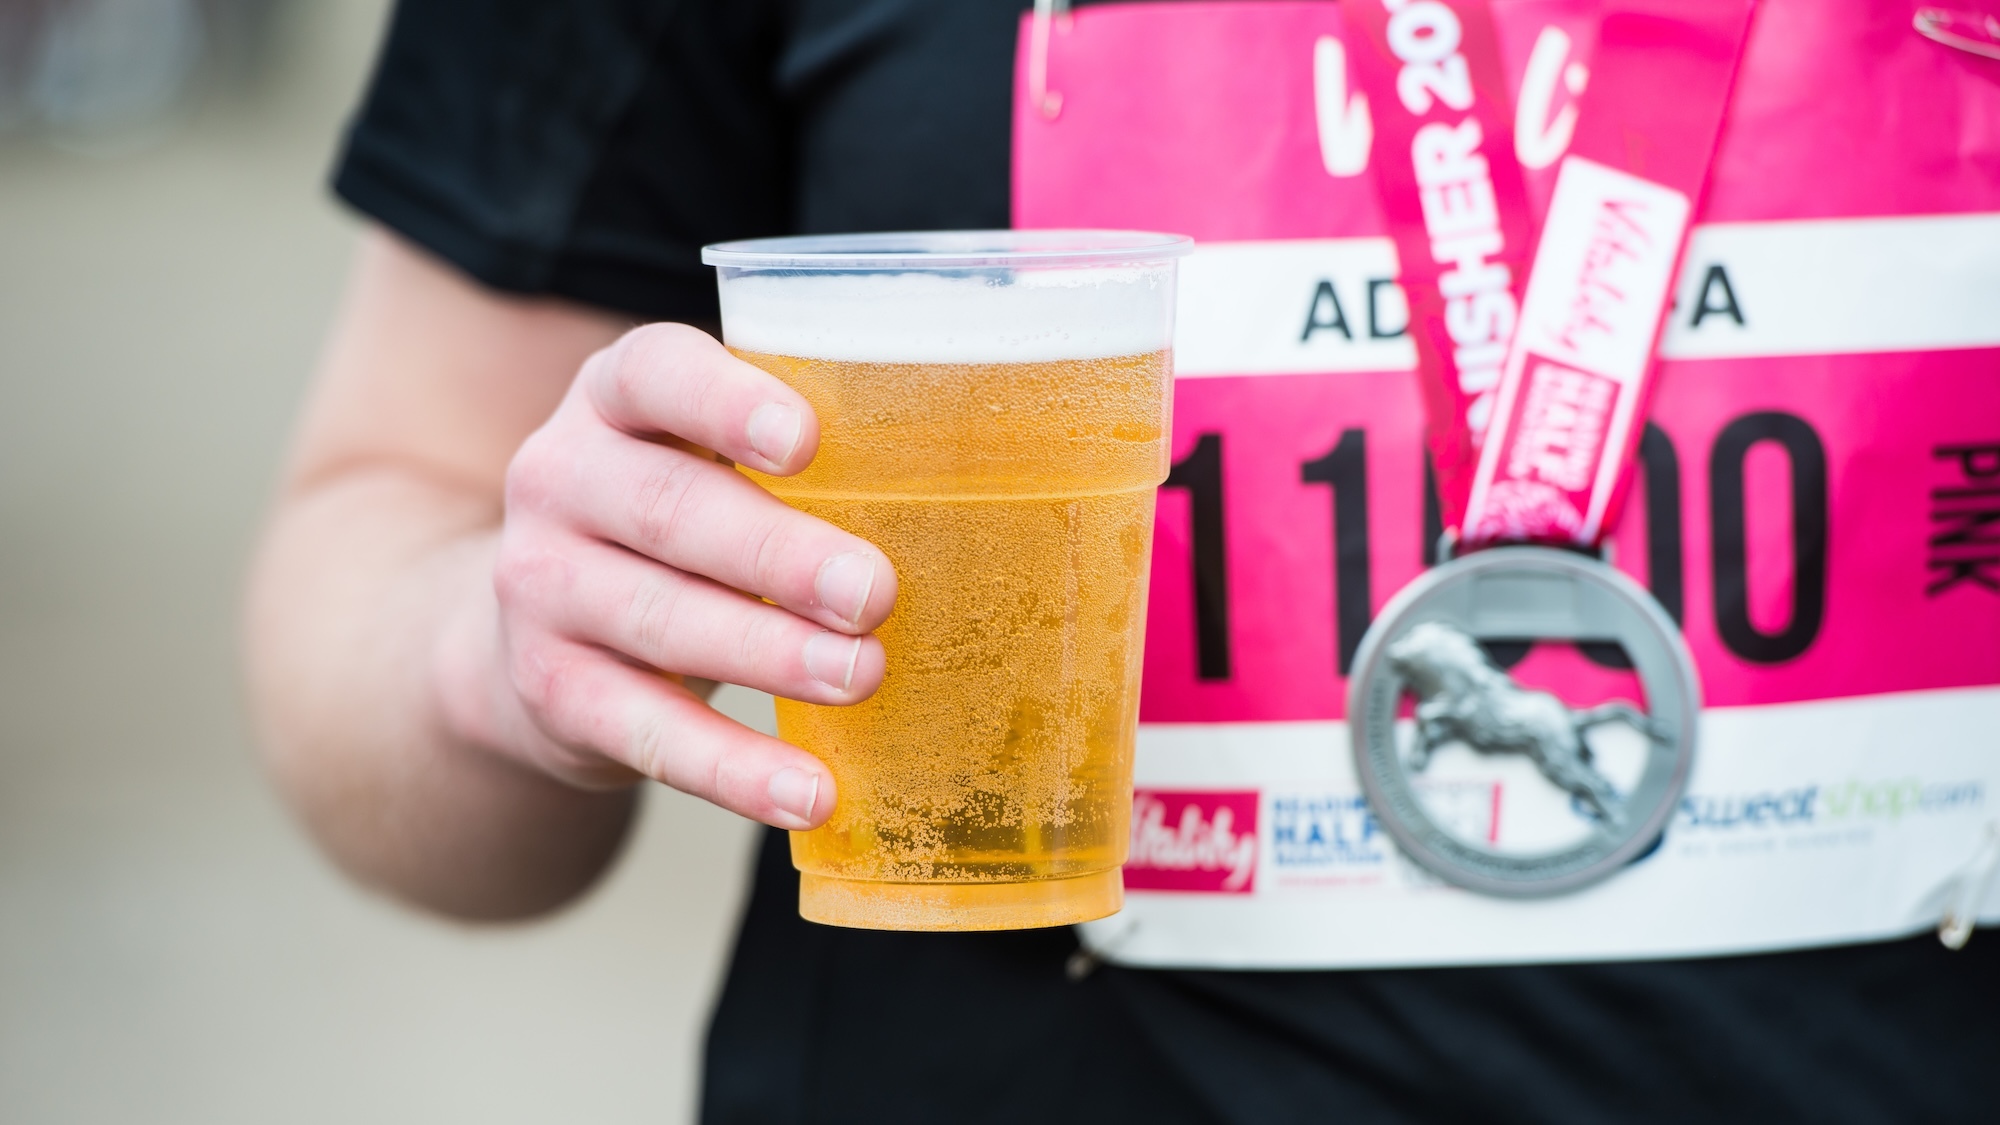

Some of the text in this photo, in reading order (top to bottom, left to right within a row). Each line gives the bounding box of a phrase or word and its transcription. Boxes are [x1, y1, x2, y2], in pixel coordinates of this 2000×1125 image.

[1384, 0, 1518, 446] NISHER 20
[1546, 200, 1652, 352] Vitality
[1162, 412, 1828, 680] 1100
[1926, 442, 2000, 597] PINK
